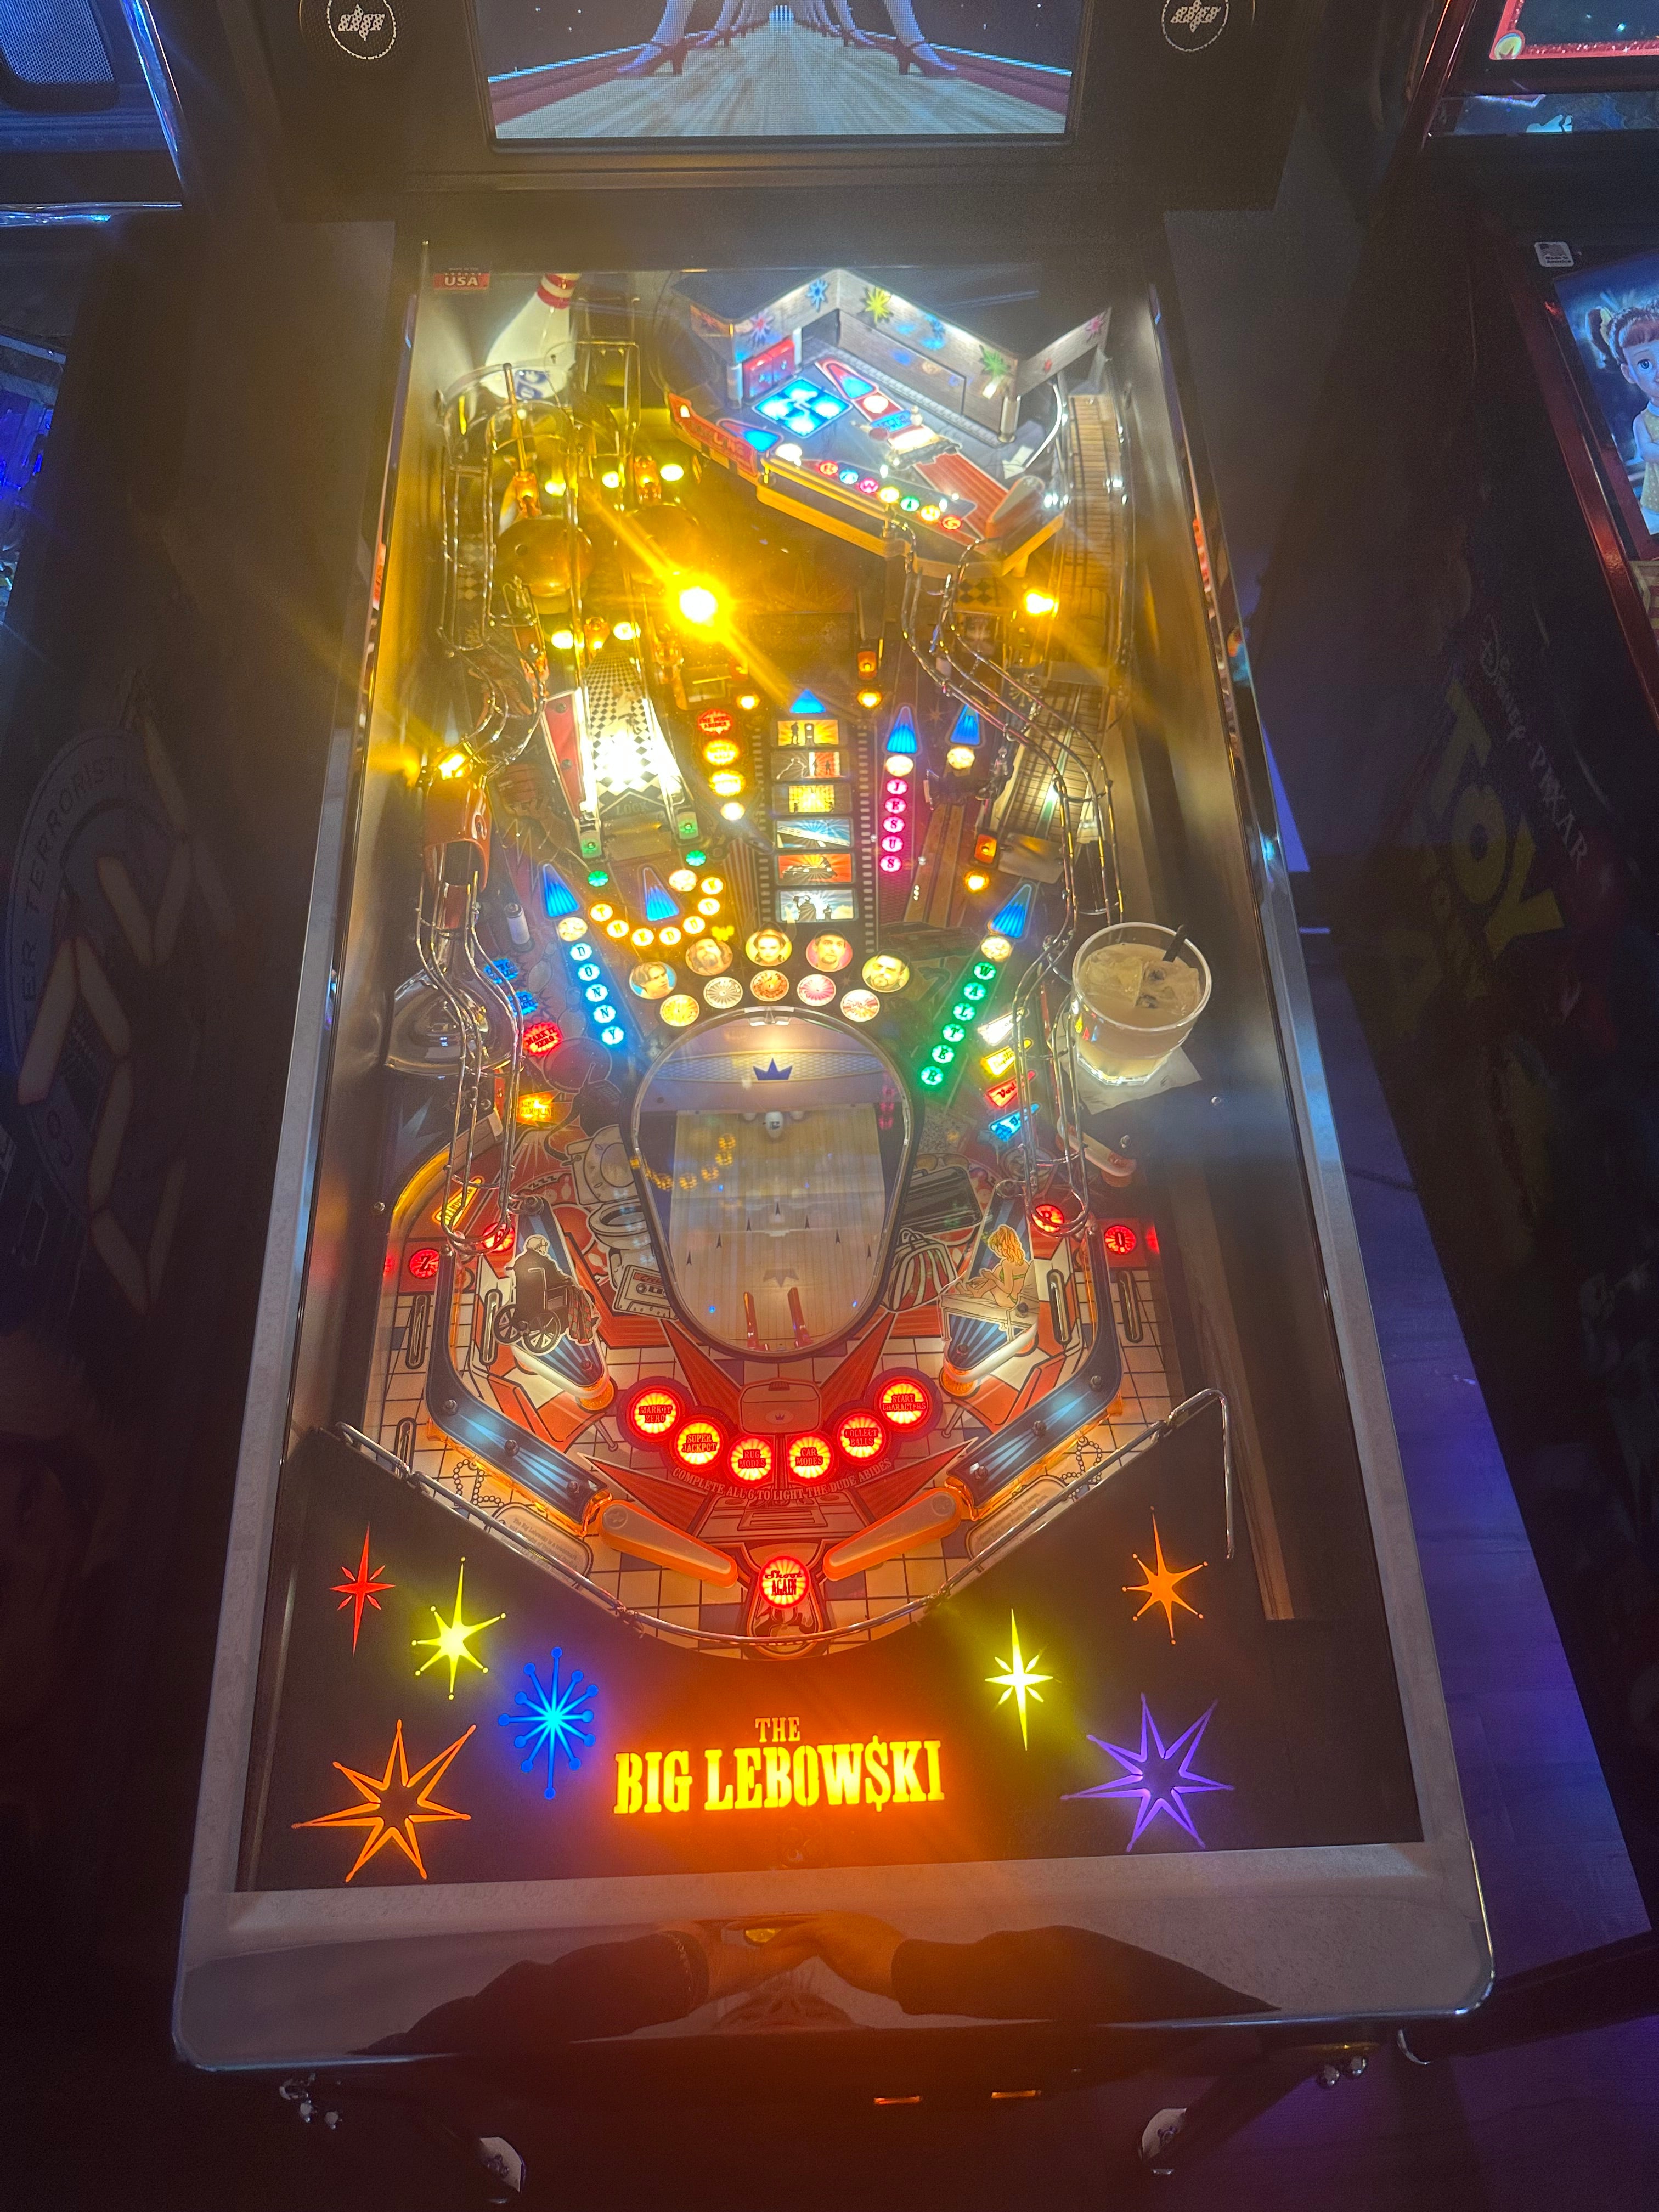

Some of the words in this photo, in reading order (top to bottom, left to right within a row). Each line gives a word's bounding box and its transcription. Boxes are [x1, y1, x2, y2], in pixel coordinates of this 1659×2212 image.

[444, 276, 478, 286] USA
[616, 800, 651, 816] LOCK
[525, 1029, 549, 1046] MARK
[548, 1025, 556, 1035] IT
[535, 1034, 555, 1049] ZERO
[996, 1082, 1017, 1099] Vod
[892, 1395, 915, 1403] START
[640, 1406, 664, 1414] MARK
[663, 1406, 672, 1414] IT
[882, 1403, 926, 1411] CHARACTERS
[645, 1414, 665, 1423] ZERO
[845, 1429, 878, 1437] COLLECT
[687, 1434, 712, 1443] SUPER
[850, 1437, 874, 1446] BALLS
[682, 1442, 716, 1452] JACKPOT
[744, 1450, 760, 1459] RUG
[802, 1448, 816, 1457] CAR
[738, 1459, 765, 1468] MODES
[796, 1457, 823, 1465] MODES
[672, 1466, 726, 1494] COMPLETE
[726, 1486, 746, 1499] ALL
[747, 1489, 754, 1499] 6
[757, 1490, 771, 1500] TO
[772, 1488, 804, 1501] LIGHT
[806, 1485, 829, 1498] THE
[830, 1474, 857, 1493] DUDE
[858, 1458, 893, 1483] ABIDES
[765, 1570, 803, 1579] Shoot
[771, 1578, 797, 1596] AGAIN
[754, 1716, 802, 1743] THE
[613, 1750, 692, 1814] BIG
[703, 1735, 945, 1813] LEBOW$KI
